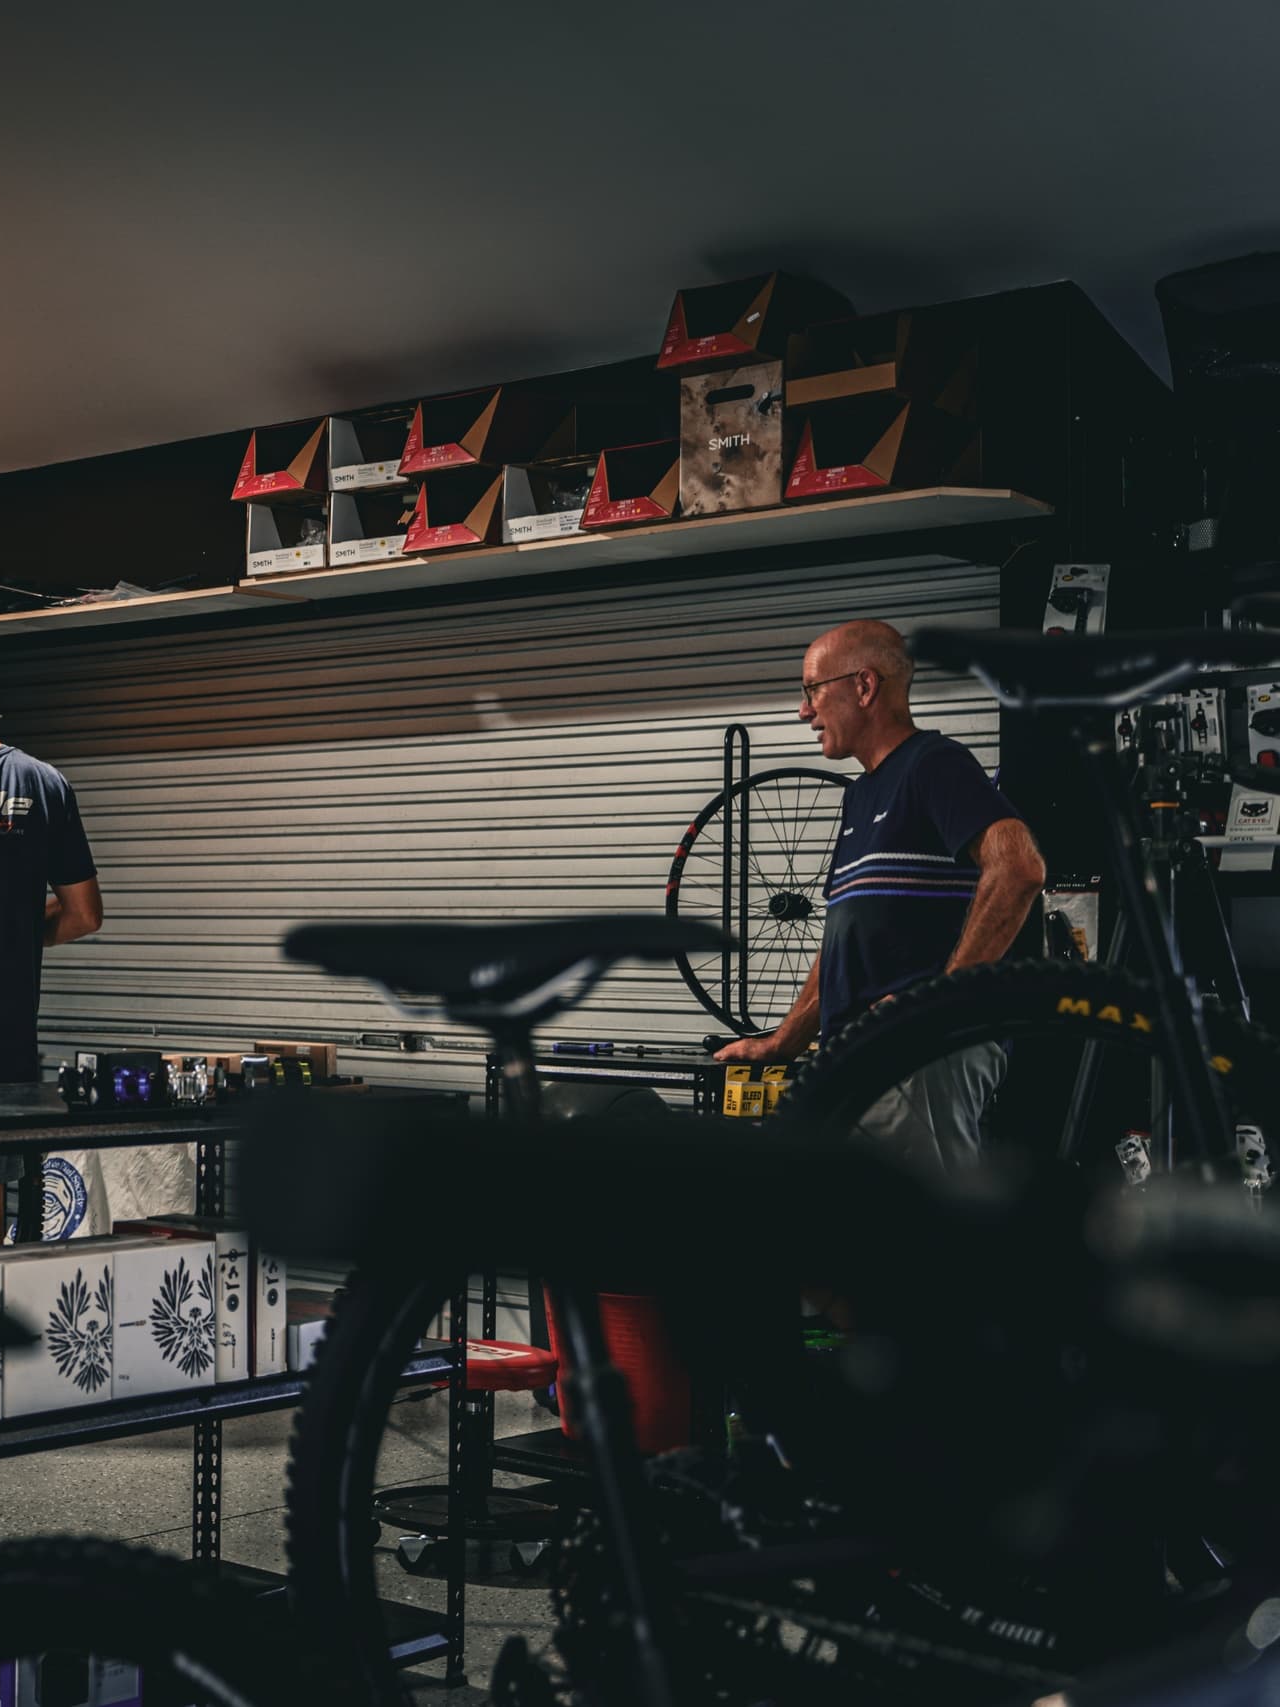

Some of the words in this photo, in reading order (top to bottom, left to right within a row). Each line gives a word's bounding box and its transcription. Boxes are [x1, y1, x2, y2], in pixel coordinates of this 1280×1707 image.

[708, 433, 750, 451] SMITH
[334, 471, 355, 484] SMITH
[509, 526, 532, 536] SMITH
[335, 549, 356, 559] SMITH
[252, 559, 273, 569] SMITH
[742, 1091, 762, 1101] BLEED
